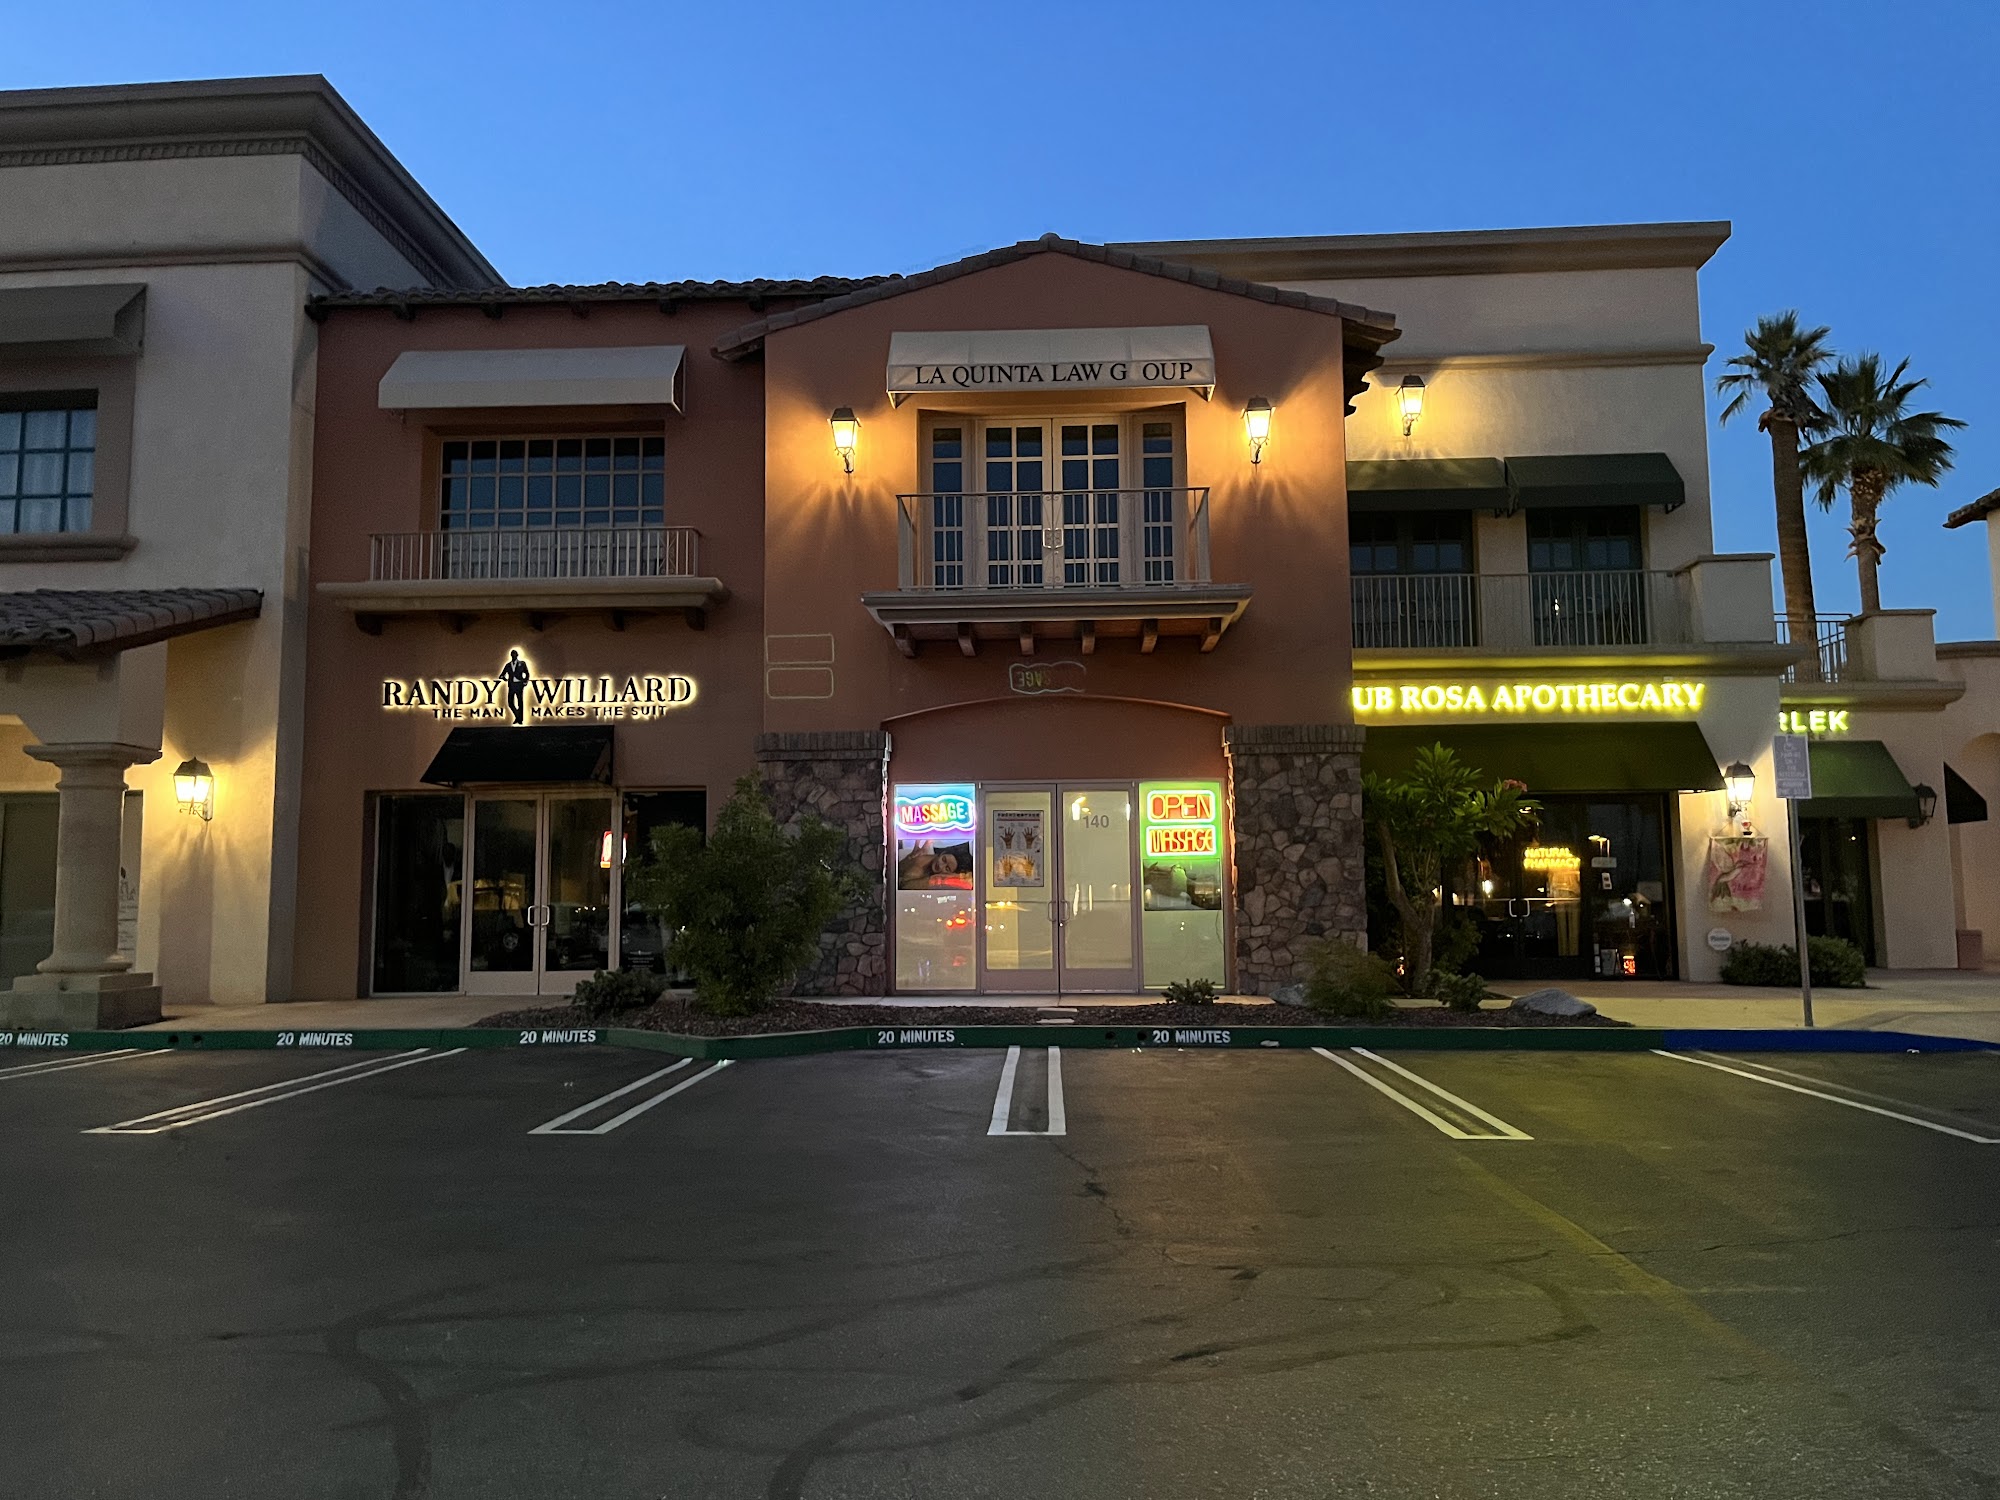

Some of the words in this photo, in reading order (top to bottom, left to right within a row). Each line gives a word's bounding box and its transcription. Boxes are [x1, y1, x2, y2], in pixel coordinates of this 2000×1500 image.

[915, 366, 946, 385] LA
[952, 365, 1044, 388] QUINTA
[1051, 363, 1103, 382] LAW
[382, 679, 501, 706] RANDY
[529, 677, 692, 705] WILLARD
[1399, 684, 1486, 711] ROSA
[1491, 682, 1705, 711] APOTHECARY
[432, 708, 463, 718] THE
[470, 707, 504, 718] MAN
[531, 706, 585, 717] MAKES
[593, 706, 623, 716] THE
[631, 705, 668, 716] SUIT
[900, 802, 966, 824] MASSAGE
[1150, 794, 1213, 819] OPEN
[1082, 814, 1110, 829] 140
[1149, 829, 1214, 853] MASSAGE
[1524, 847, 1574, 858] NATURAL
[1523, 857, 1581, 869] PHARMACY
[0, 1033, 13, 1045] 20
[17, 1033, 70, 1046] MINUTES
[276, 1032, 294, 1046] 20
[299, 1032, 353, 1046] MINUTES
[519, 1030, 537, 1044] 20
[542, 1030, 596, 1043] MINUTES
[878, 1030, 895, 1044] 20
[900, 1030, 955, 1043] MINUTES
[1152, 1030, 1170, 1043] 20
[1175, 1030, 1231, 1043] MINUTES
